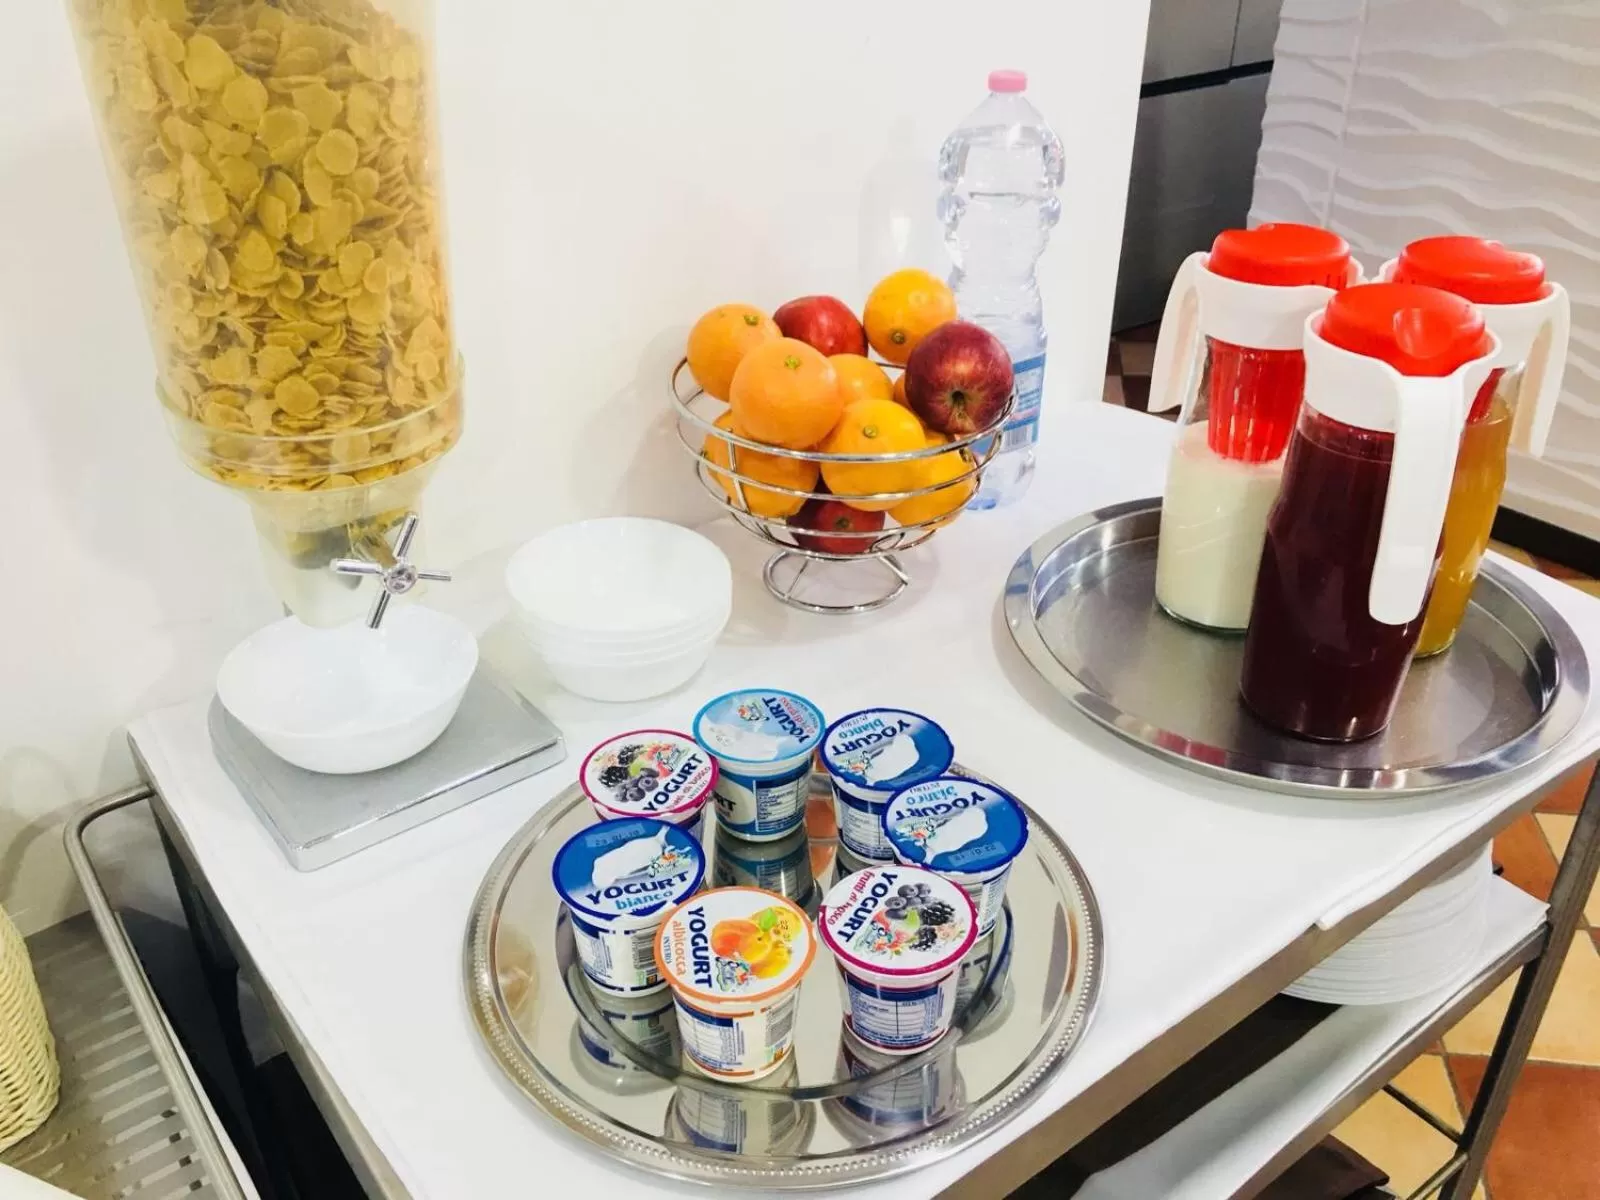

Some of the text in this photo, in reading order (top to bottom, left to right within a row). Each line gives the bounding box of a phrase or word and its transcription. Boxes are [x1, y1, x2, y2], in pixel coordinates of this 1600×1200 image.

[762, 697, 810, 743] YOGURT
[832, 719, 911, 756] YOGURT
[643, 753, 703, 811] YOGURT
[895, 791, 986, 820] YOGURT
[586, 870, 689, 905] YOGURT
[614, 890, 673, 911] bianco
[837, 871, 898, 943] YOGURT
[672, 920, 687, 976] albicocca
[688, 905, 712, 989] YOGURT
